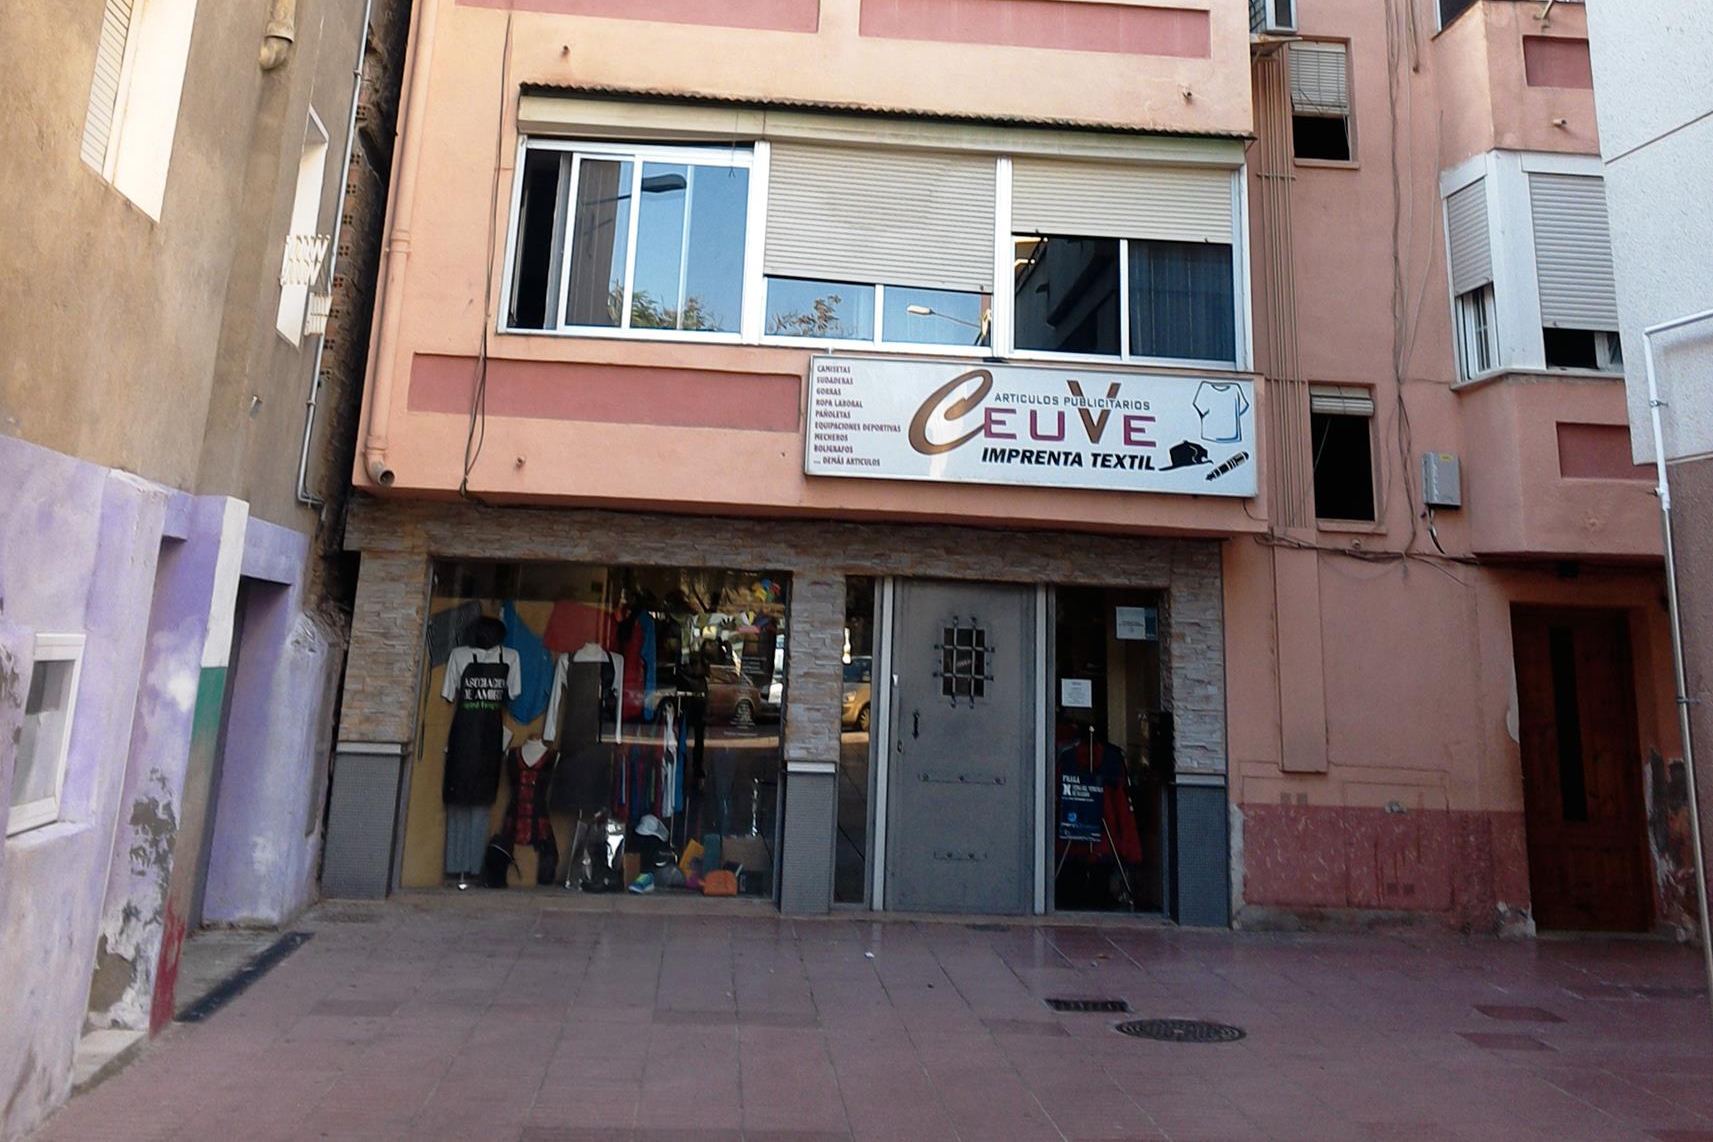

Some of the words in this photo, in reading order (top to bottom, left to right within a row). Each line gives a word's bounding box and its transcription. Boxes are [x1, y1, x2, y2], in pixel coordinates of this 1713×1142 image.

[817, 364, 851, 374] CAMISETAS
[816, 377, 853, 385] SUDADERAS
[816, 387, 841, 395] GORRAS
[816, 398, 833, 407] ROPA
[834, 399, 863, 408] LABORAL
[994, 392, 1059, 406] ARTICULOS
[1063, 396, 1151, 411] PUBLICITARIOS
[815, 409, 851, 419] PAÑOLETAS
[815, 421, 861, 431] EQUIPACIONES
[862, 423, 901, 433] DEPORTIVAS
[814, 433, 848, 442] MECHEROS
[846, 457, 881, 466] ARTICULOS
[981, 446, 1083, 468] IMPRENTA
[1090, 452, 1156, 471] TEXTIL
